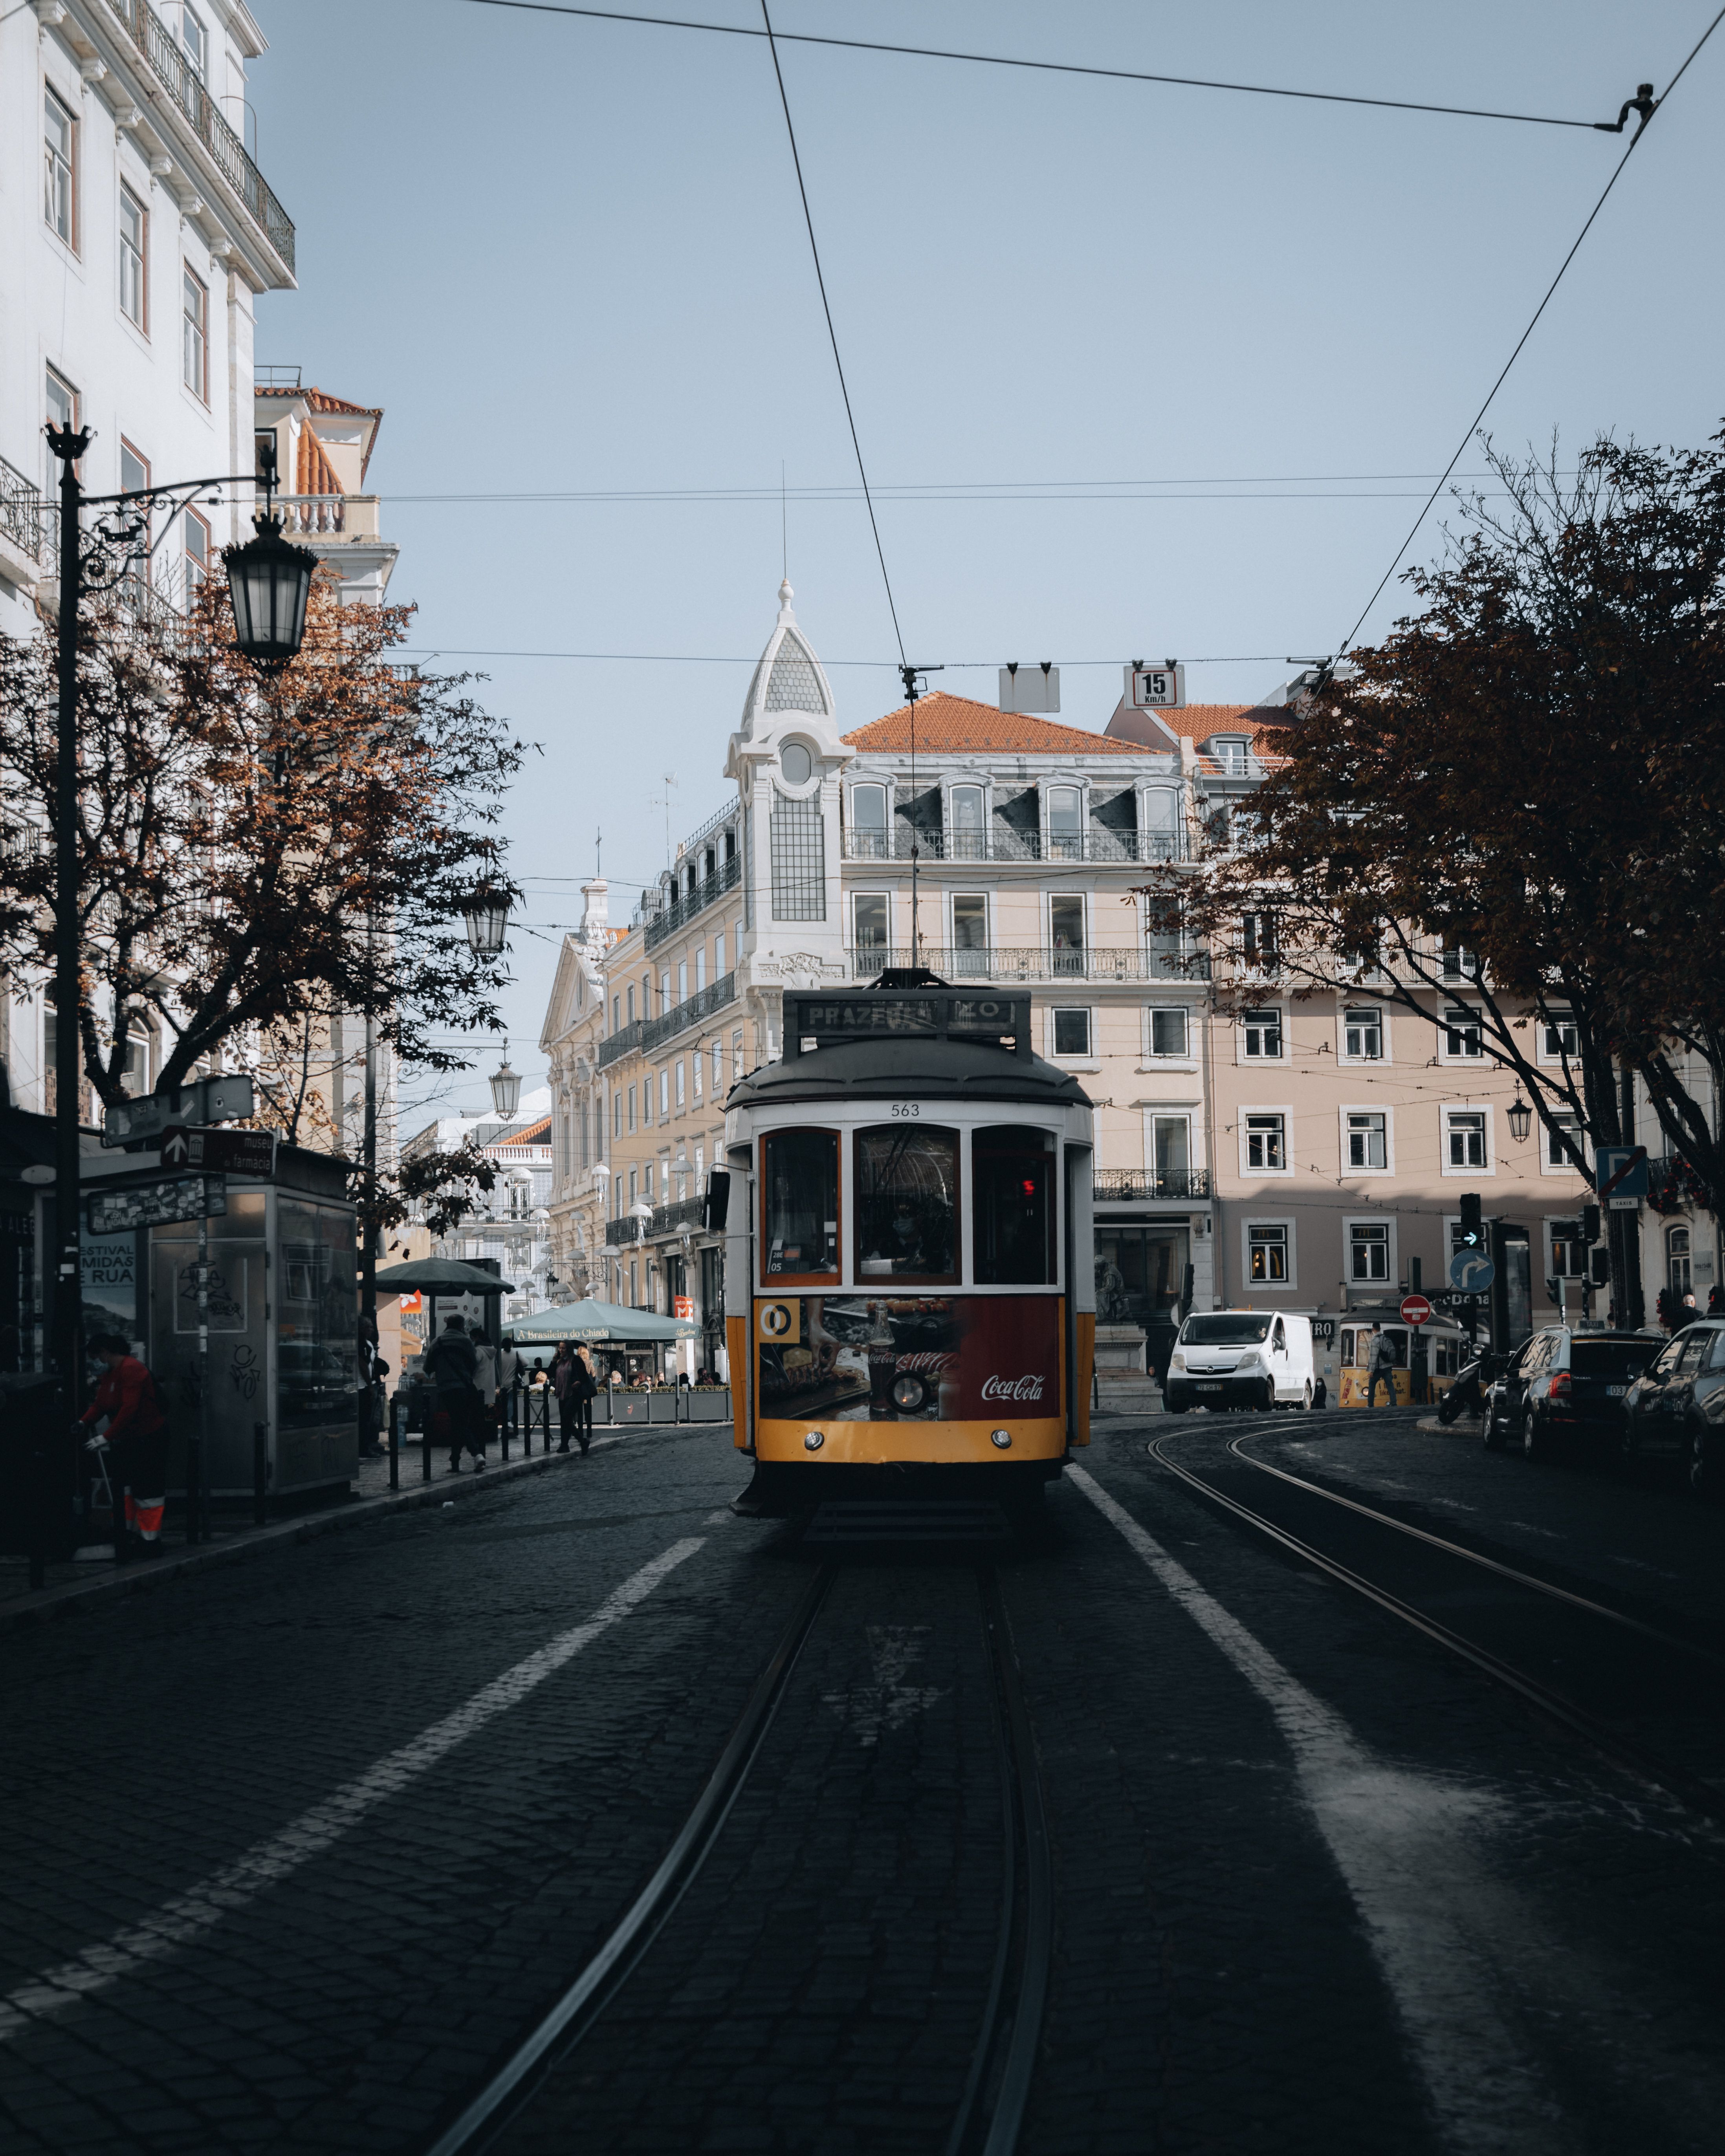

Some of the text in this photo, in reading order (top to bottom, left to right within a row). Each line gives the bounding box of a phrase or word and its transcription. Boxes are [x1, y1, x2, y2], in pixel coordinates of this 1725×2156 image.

[1142, 674, 1166, 694] 15
[1145, 695, 1166, 703] Km/h
[891, 1104, 919, 1116] 563
[244, 1138, 272, 1149] museu
[234, 1154, 271, 1170] farmácia
[771, 1263, 782, 1271] 05
[93, 1269, 134, 1283] RUA
[517, 1328, 609, 1339] A Brasileira do Chiado
[981, 1375, 1046, 1401] Coca-Cola
